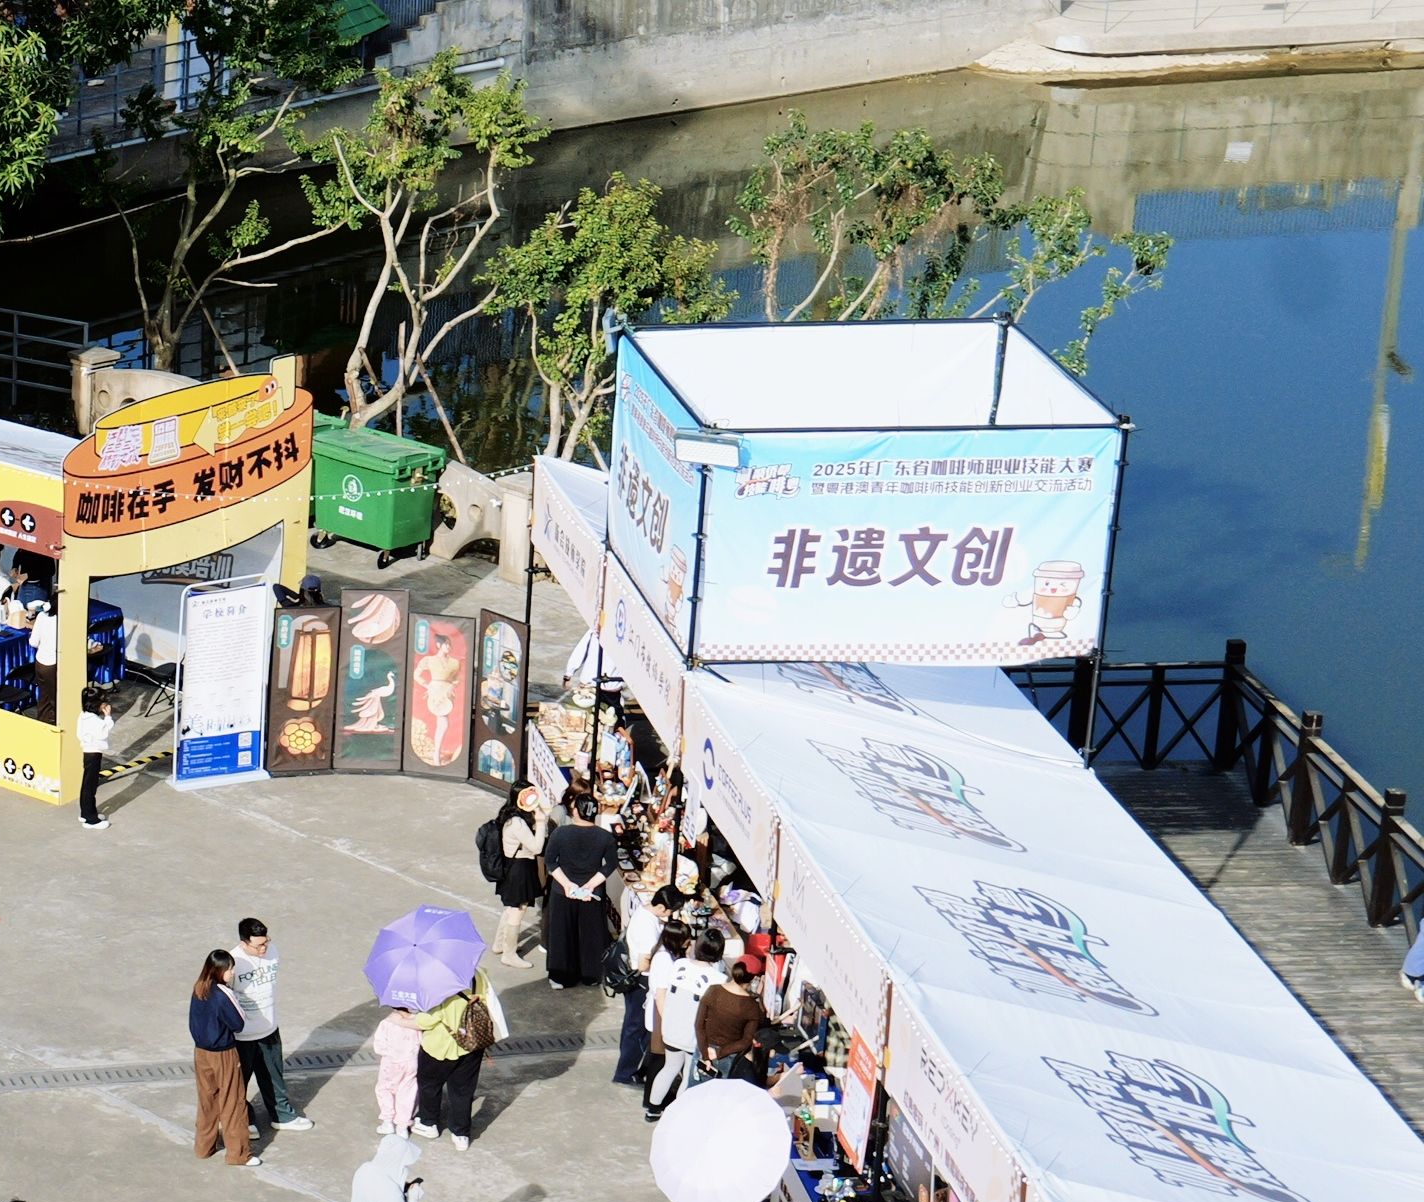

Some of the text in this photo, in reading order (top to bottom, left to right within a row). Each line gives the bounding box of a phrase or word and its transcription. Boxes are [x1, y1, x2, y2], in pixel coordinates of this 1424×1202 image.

[76, 480, 175, 524] 咖啡在手
[193, 432, 300, 502] 发财不抖
[811, 478, 1092, 496] 暨粤港澳青年咖啡师技能创新创业交流活动
[813, 457, 1094, 477] 2025年广东省咖啡师职业技能大赛
[617, 445, 669, 554] 非遗文创
[767, 526, 1014, 588] 非遗文创
